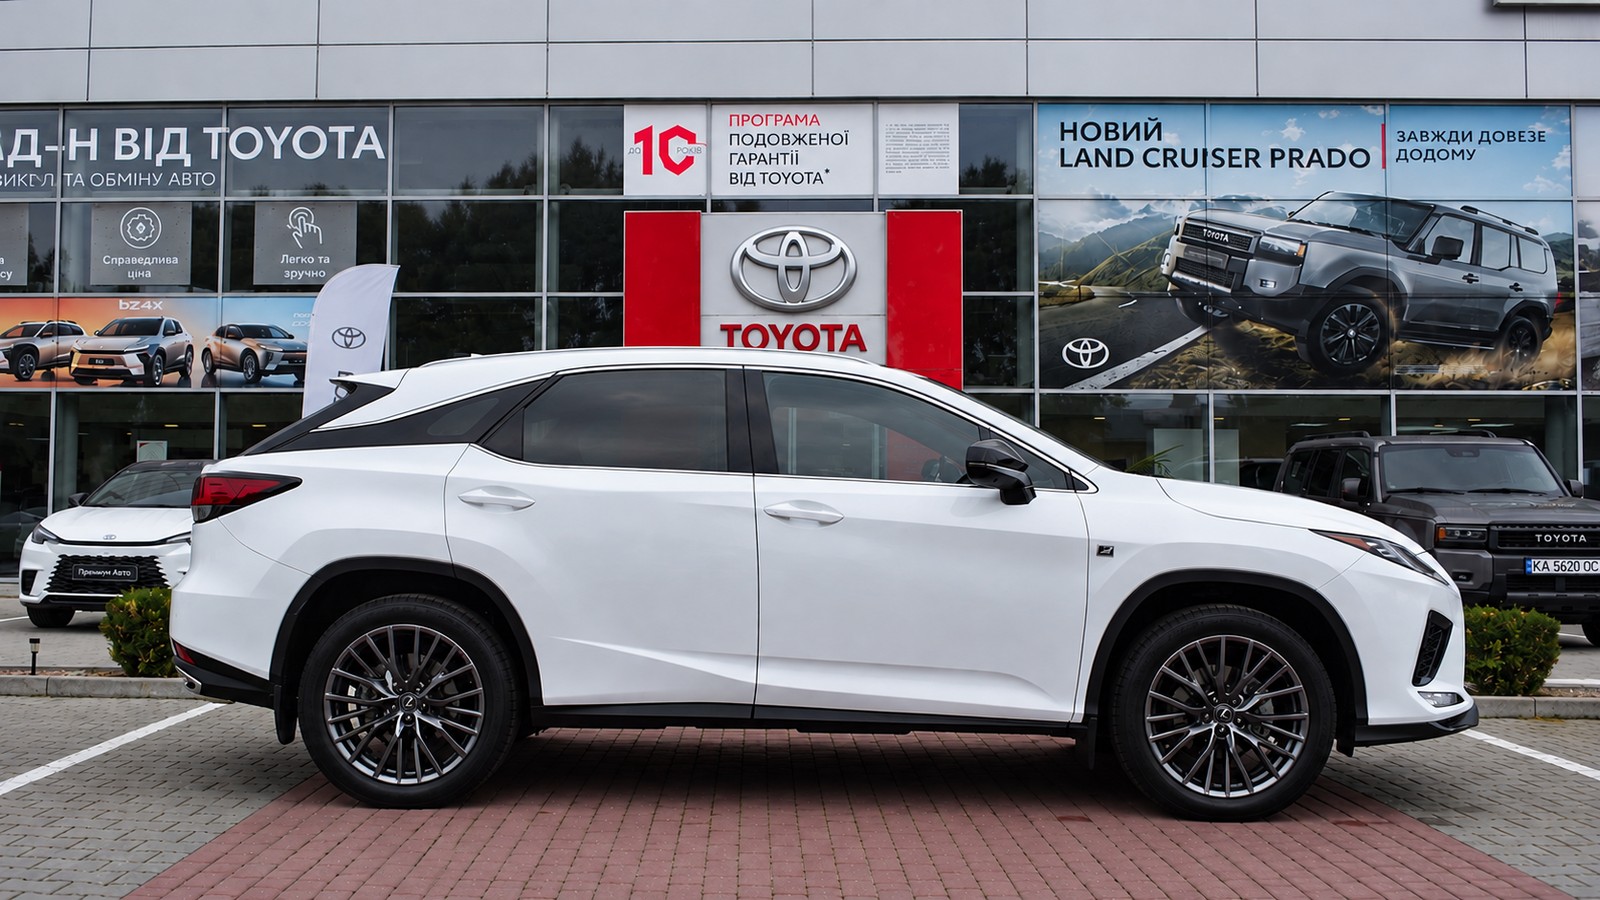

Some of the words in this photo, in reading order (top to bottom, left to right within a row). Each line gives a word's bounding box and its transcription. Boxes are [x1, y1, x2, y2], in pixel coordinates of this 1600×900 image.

[729, 114, 821, 127] ПРОГРАМА
[1060, 117, 1162, 142] НОВИЙ
[729, 130, 849, 148] ПОДОВЖЕНОЇ
[1396, 130, 1473, 145] ЗАВЖДИ
[1478, 130, 1547, 145] ДОВЕЗЕ
[0, 129, 98, 168] Д-Н
[114, 127, 191, 167] ВІД
[203, 125, 386, 161] TOYOTA
[676, 147, 702, 155] РОКІВ
[729, 150, 799, 165] ГАРАНТІЇ
[1060, 147, 1134, 168] LAND
[1142, 147, 1261, 168] CRUISER
[1270, 147, 1371, 169] PRADO
[1396, 148, 1477, 163] ДОДОМУ
[63, 173, 85, 187] ТА
[90, 172, 163, 187] ОБМІНУ
[168, 172, 216, 186] АВТО
[729, 172, 756, 187] ВІД
[1203, 228, 1229, 242] TOYOTA
[102, 255, 179, 266] Справедлива
[280, 254, 315, 264] Легко
[318, 256, 330, 264] та
[127, 269, 152, 280] ціна
[284, 270, 326, 280] зручно
[720, 323, 868, 352] TOYOTA
[1535, 534, 1587, 542] TOYOTA
[1533, 561, 1550, 572] KA
[1553, 561, 1580, 572] 5620
[1583, 561, 1599, 572] OC
